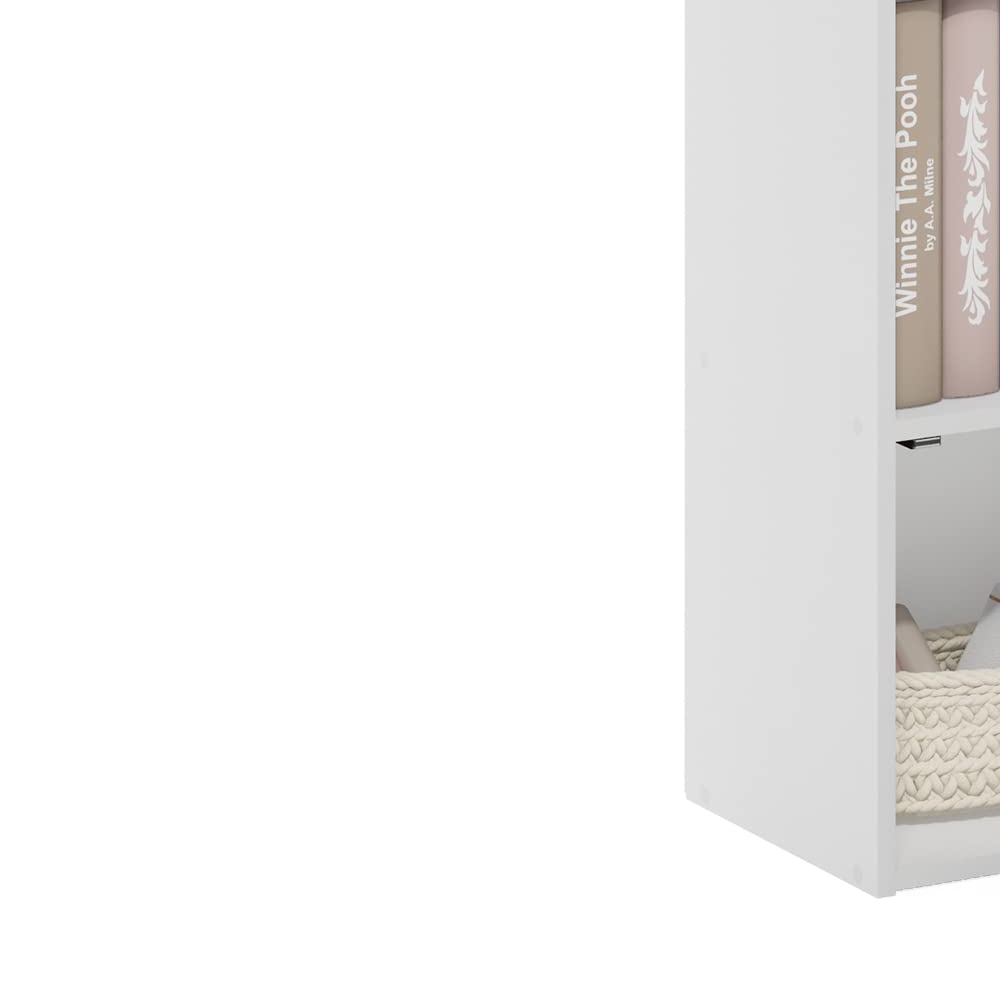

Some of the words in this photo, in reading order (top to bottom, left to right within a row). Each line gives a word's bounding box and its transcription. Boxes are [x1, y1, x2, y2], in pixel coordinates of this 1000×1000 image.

[895, 73, 918, 149] Pooh
[895, 157, 918, 212] The
[924, 157, 935, 197] Milne
[924, 200, 935, 231] A.A.
[924, 233, 937, 252] by
[895, 218, 918, 318] Winnie
